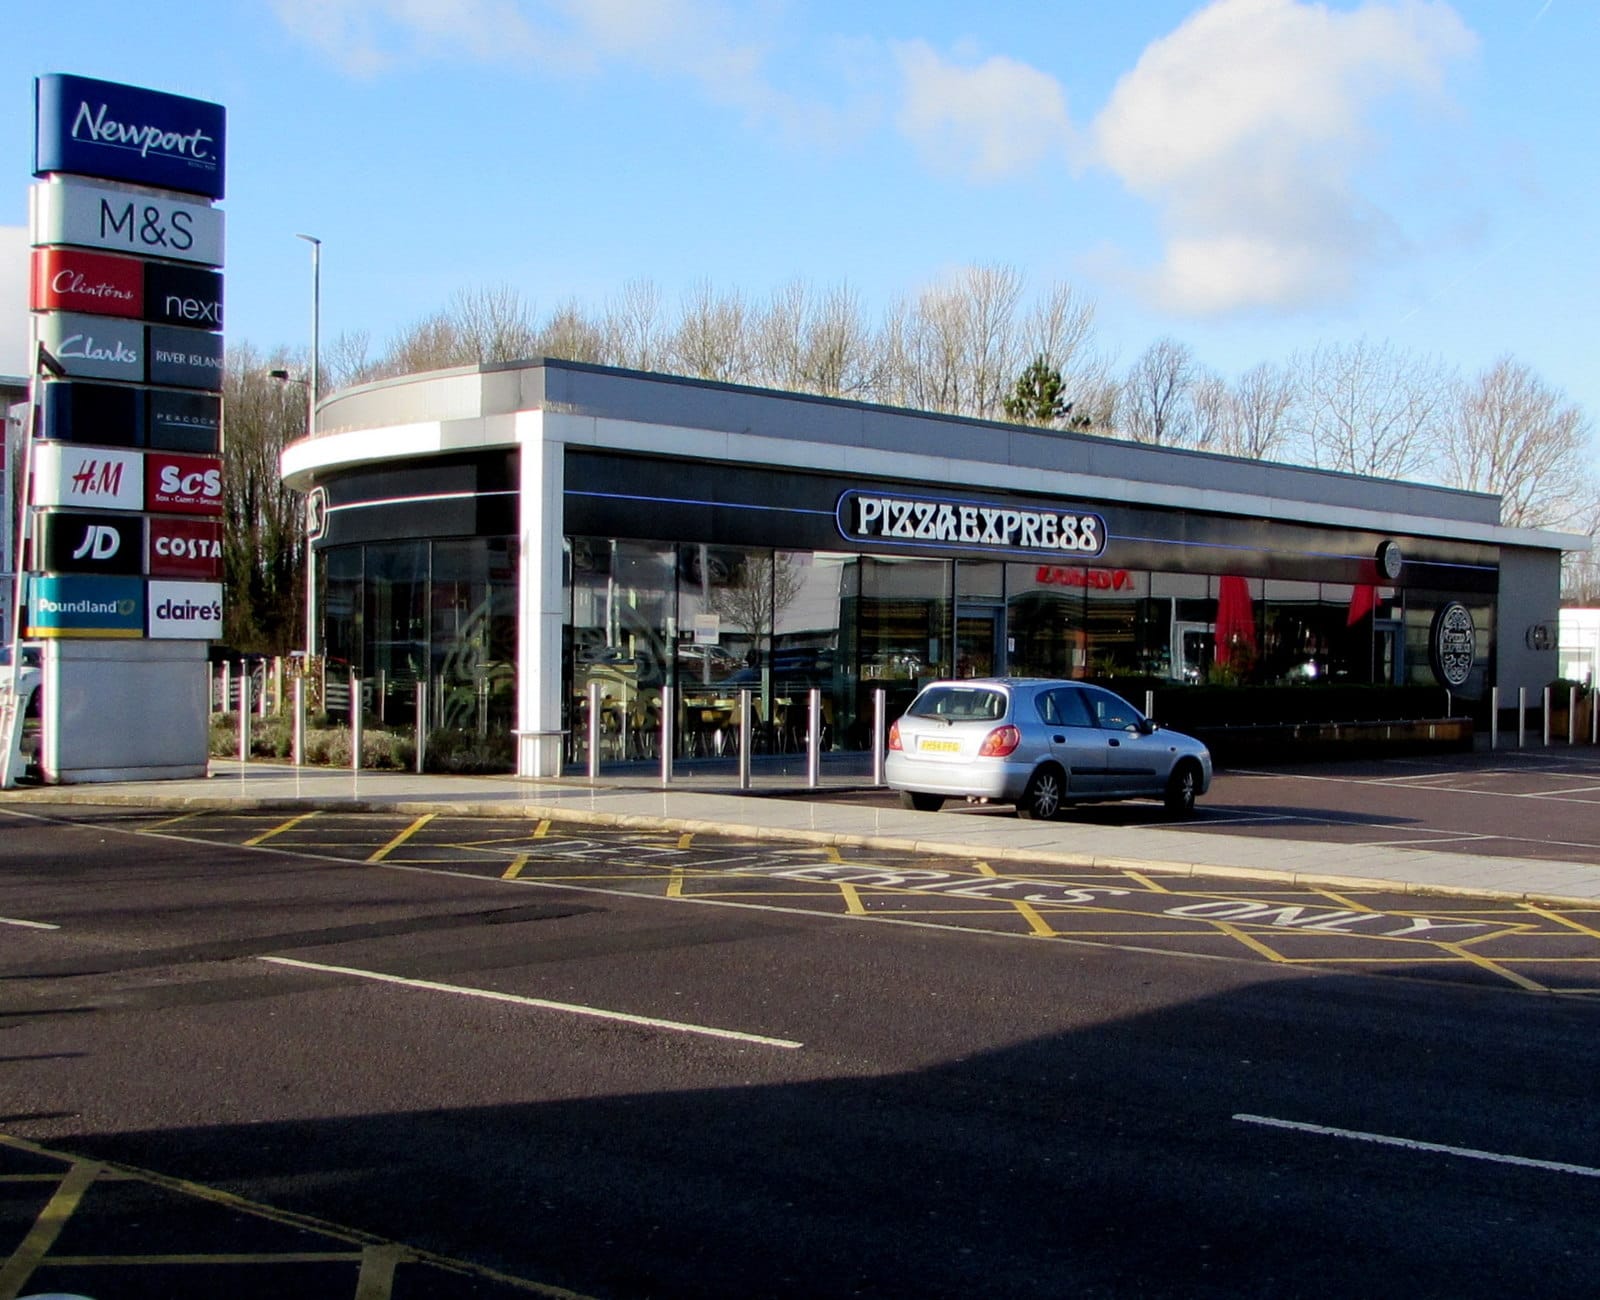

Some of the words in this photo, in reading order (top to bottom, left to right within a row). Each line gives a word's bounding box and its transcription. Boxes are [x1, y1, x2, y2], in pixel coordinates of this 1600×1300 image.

[100, 198, 193, 251] M&S
[52, 269, 134, 300] Clintons
[165, 295, 223, 323] next
[56, 334, 137, 364] Clarks
[155, 350, 187, 365] RIVER
[72, 459, 124, 497] H&M
[73, 524, 121, 560] JD
[155, 536, 222, 560] COSTA
[38, 598, 117, 614] Poundland
[156, 598, 221, 621] claire's
[1163, 900, 1488, 937] ONLY
